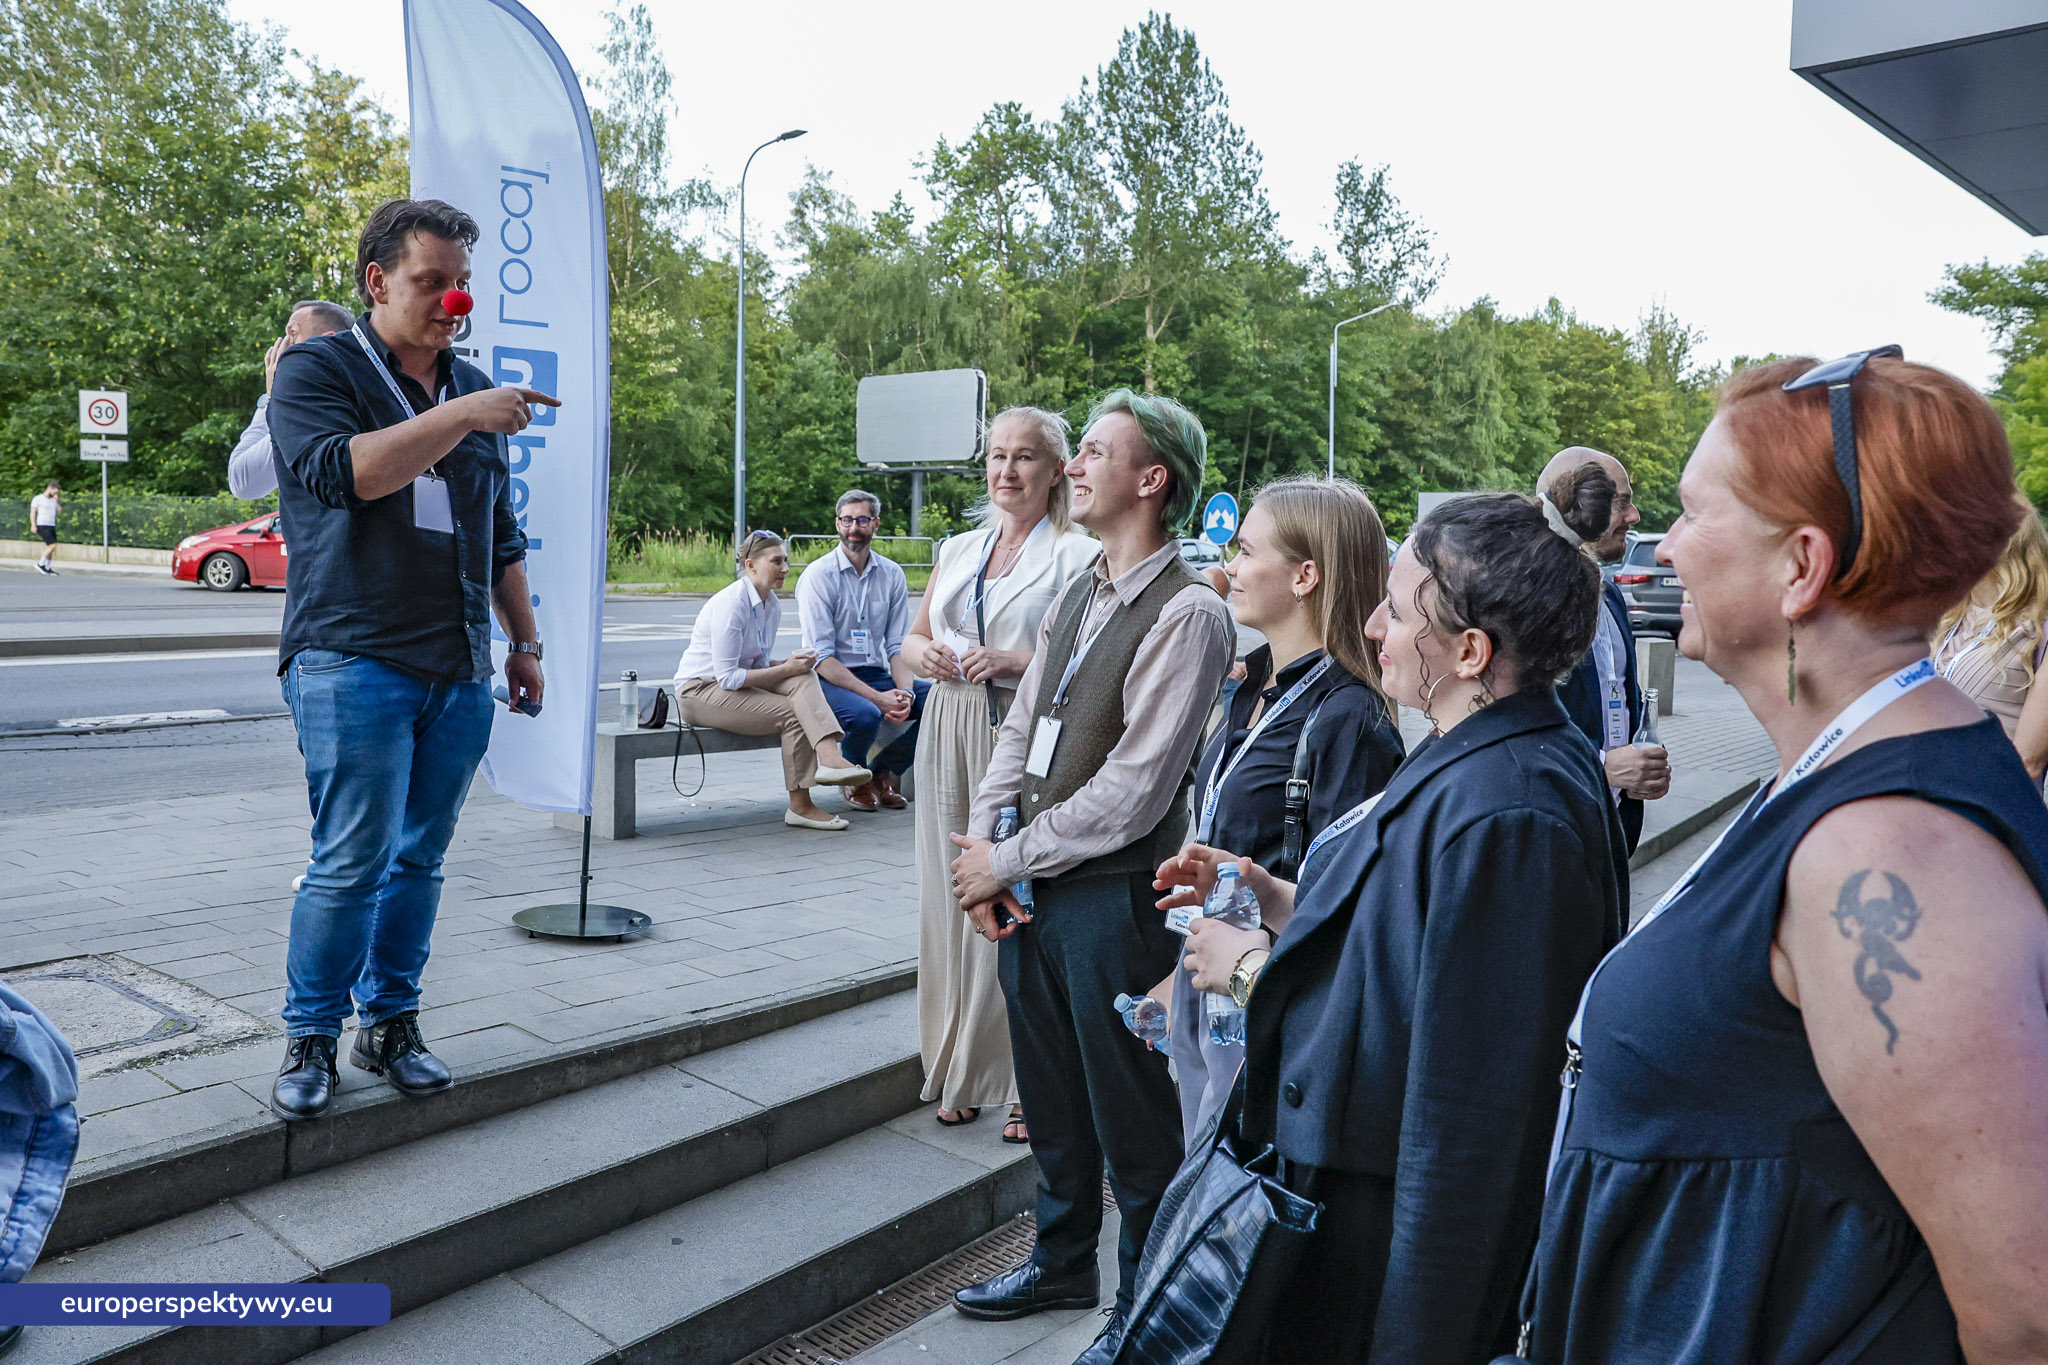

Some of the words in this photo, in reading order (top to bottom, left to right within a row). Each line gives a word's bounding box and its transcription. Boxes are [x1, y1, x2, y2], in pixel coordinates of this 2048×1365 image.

[499, 165, 550, 328] Local
[93, 406, 115, 419] 30
[1264, 696, 1291, 723] Linkedin
[1302, 662, 1328, 687] Katowice
[1795, 727, 1843, 776] Katowice
[1333, 809, 1364, 831] Katowice
